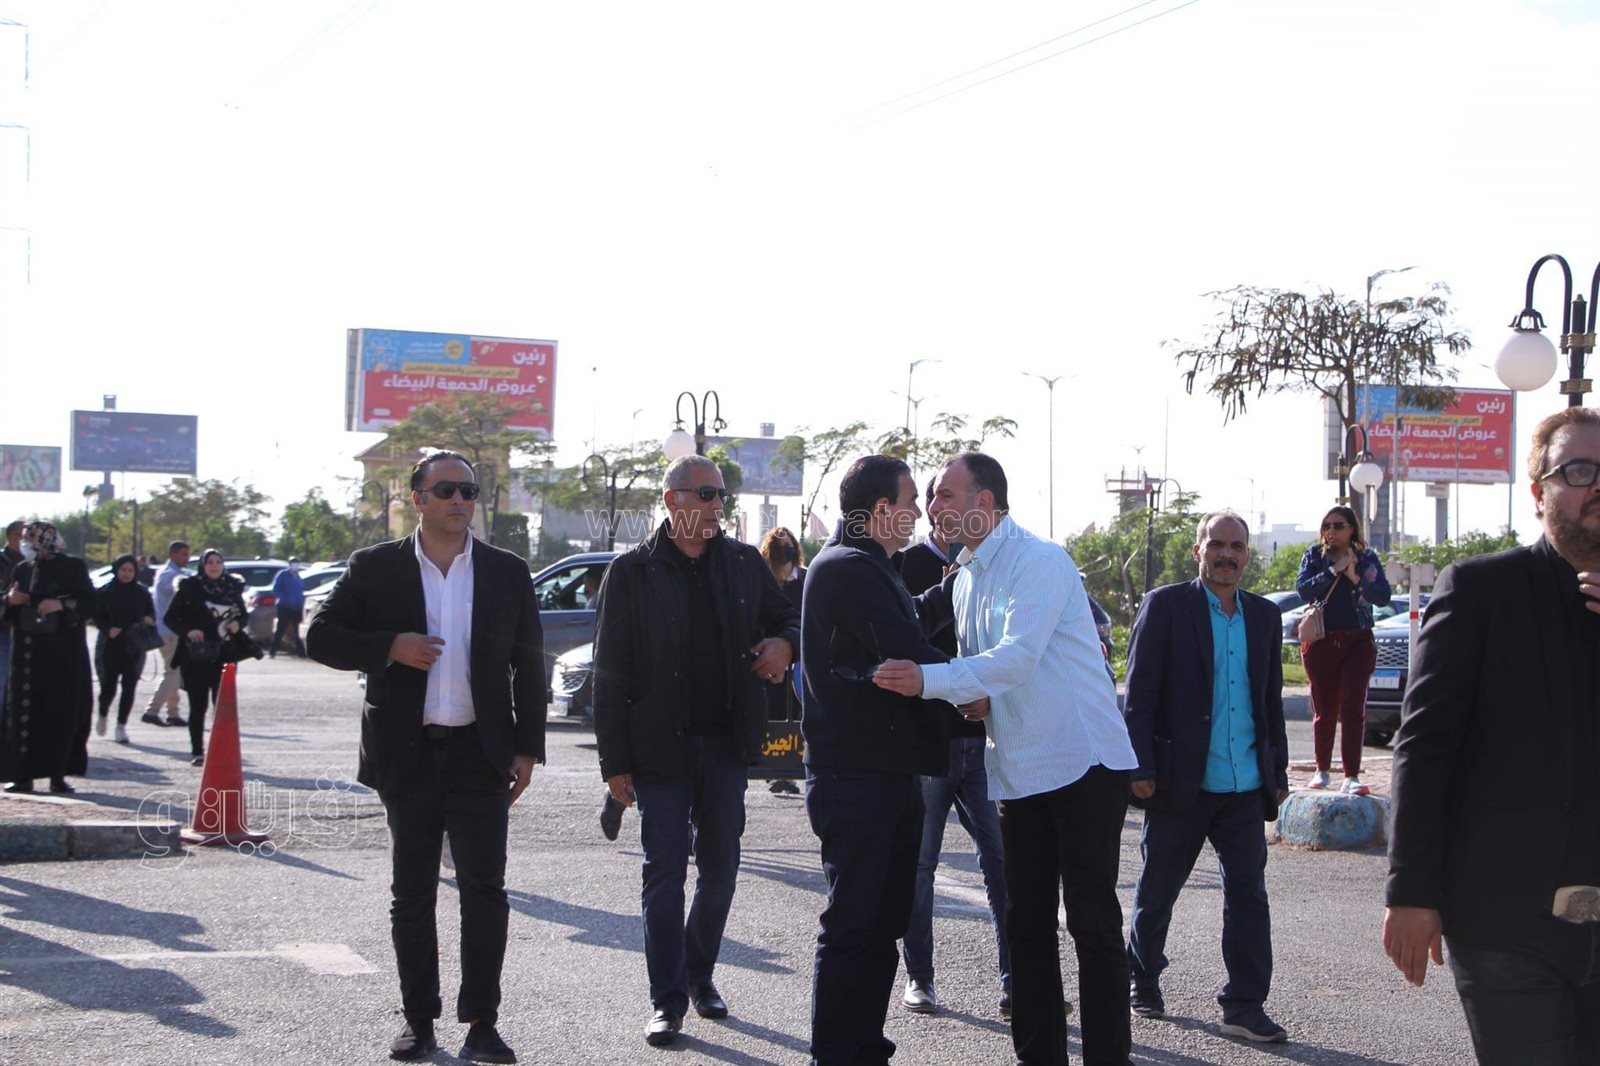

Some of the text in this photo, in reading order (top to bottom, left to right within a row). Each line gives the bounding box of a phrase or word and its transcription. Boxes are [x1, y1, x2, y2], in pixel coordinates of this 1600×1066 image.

[512, 349, 547, 366] رنين
[384, 374, 536, 394] عروض الجمعة البيضاء
[1476, 398, 1506, 414] رنين
[1412, 425, 1457, 440] الجمعة
[1458, 427, 1497, 440] عروض
[761, 732, 798, 757] الجيز
